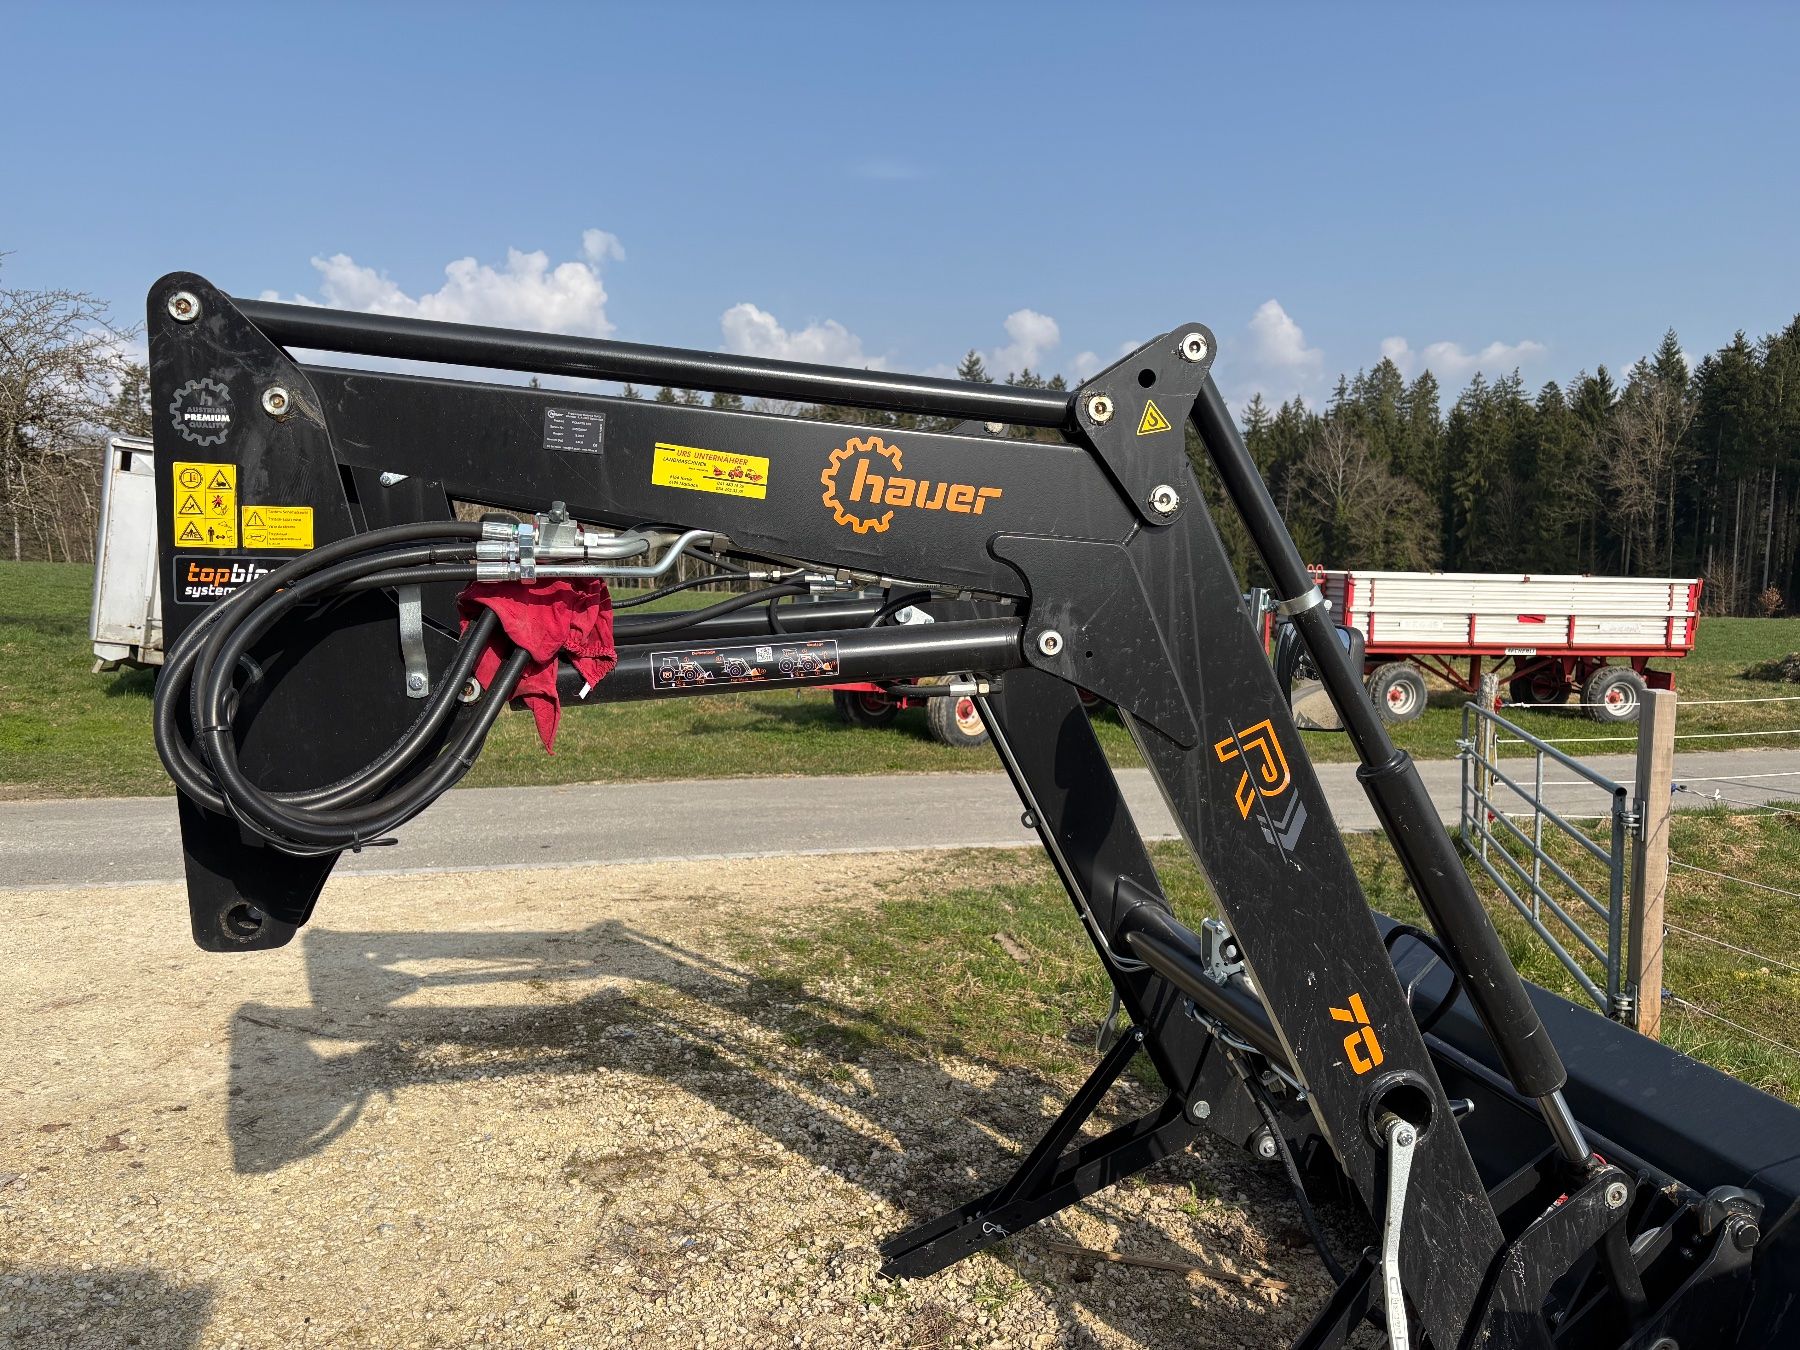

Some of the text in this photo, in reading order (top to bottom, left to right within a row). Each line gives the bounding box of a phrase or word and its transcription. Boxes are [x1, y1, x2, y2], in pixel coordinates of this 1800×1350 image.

[184, 413, 231, 422] PREMIUM
[677, 449, 749, 466] URS UNTERNÄHRER
[849, 458, 1003, 515] hauer
[1329, 992, 1384, 1075] 70
